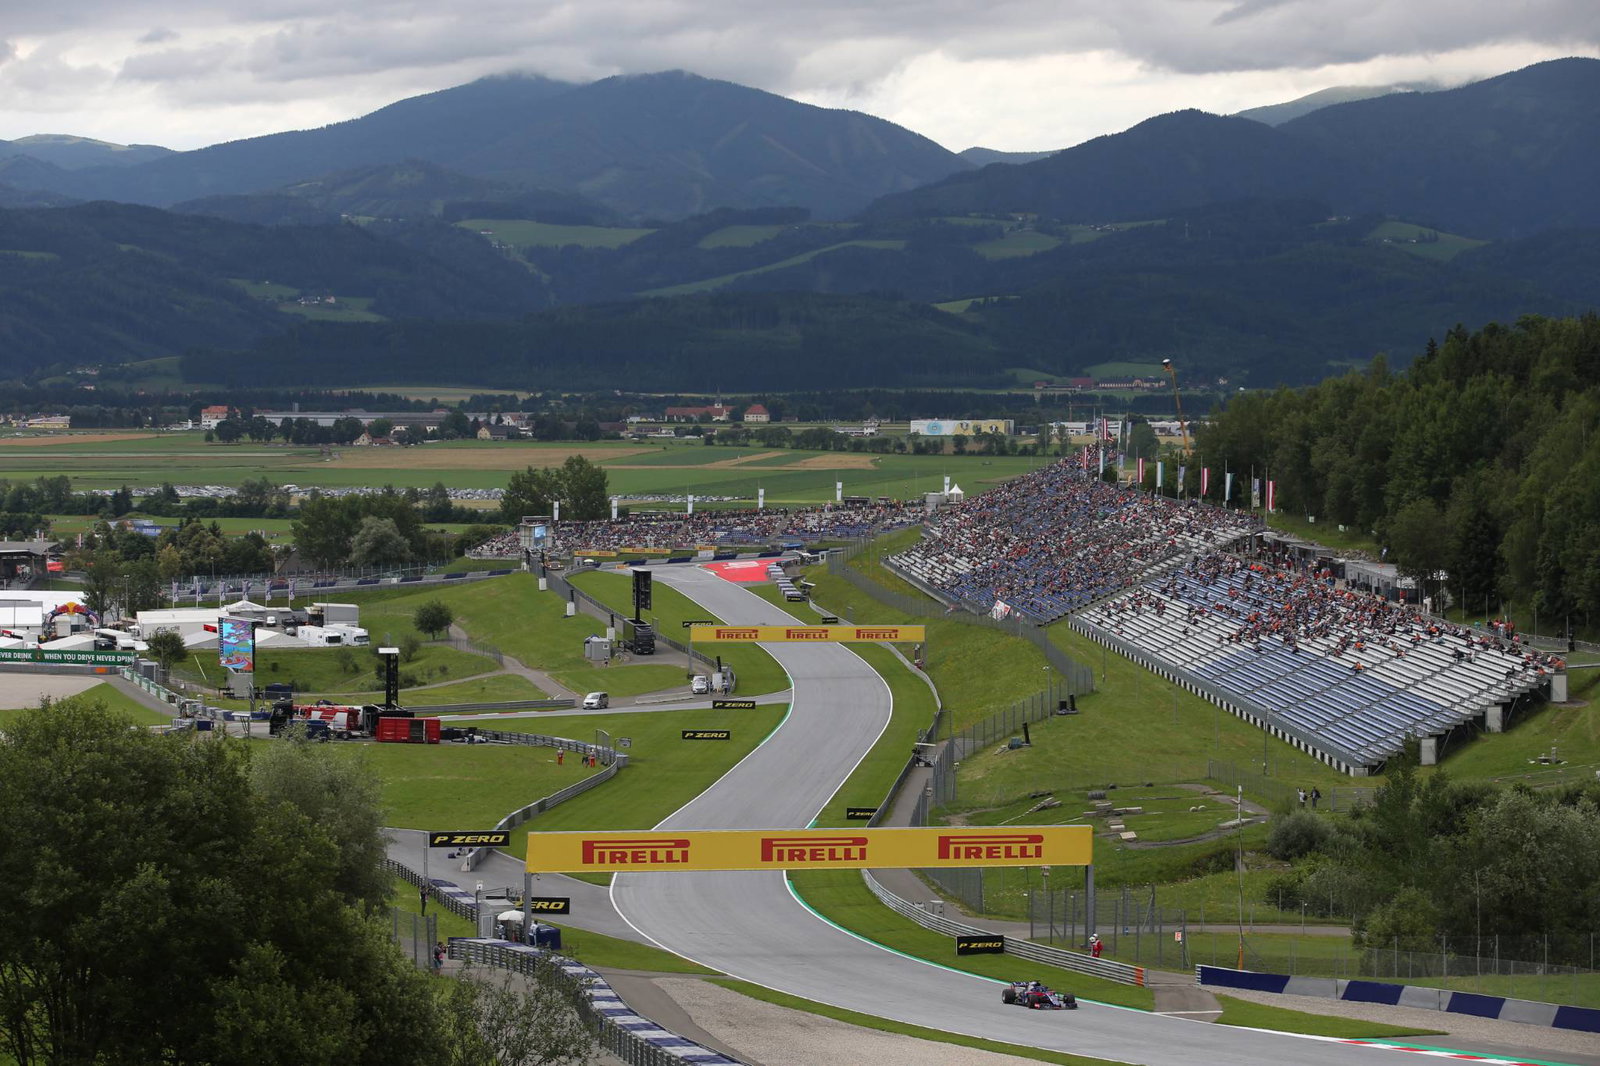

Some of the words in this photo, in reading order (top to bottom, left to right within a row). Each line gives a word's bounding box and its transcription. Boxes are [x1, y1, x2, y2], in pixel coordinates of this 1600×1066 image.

[716, 629, 759, 639] PIRELLI
[786, 629, 829, 639] PIRELLI
[855, 629, 899, 639] PIRELLI
[0, 651, 12, 659] EVER
[434, 835, 449, 844] P
[451, 835, 505, 844] ZERO
[582, 839, 691, 865] PIRELLI
[761, 837, 869, 862] PIRELLI
[938, 834, 1045, 860] PIRELLI
